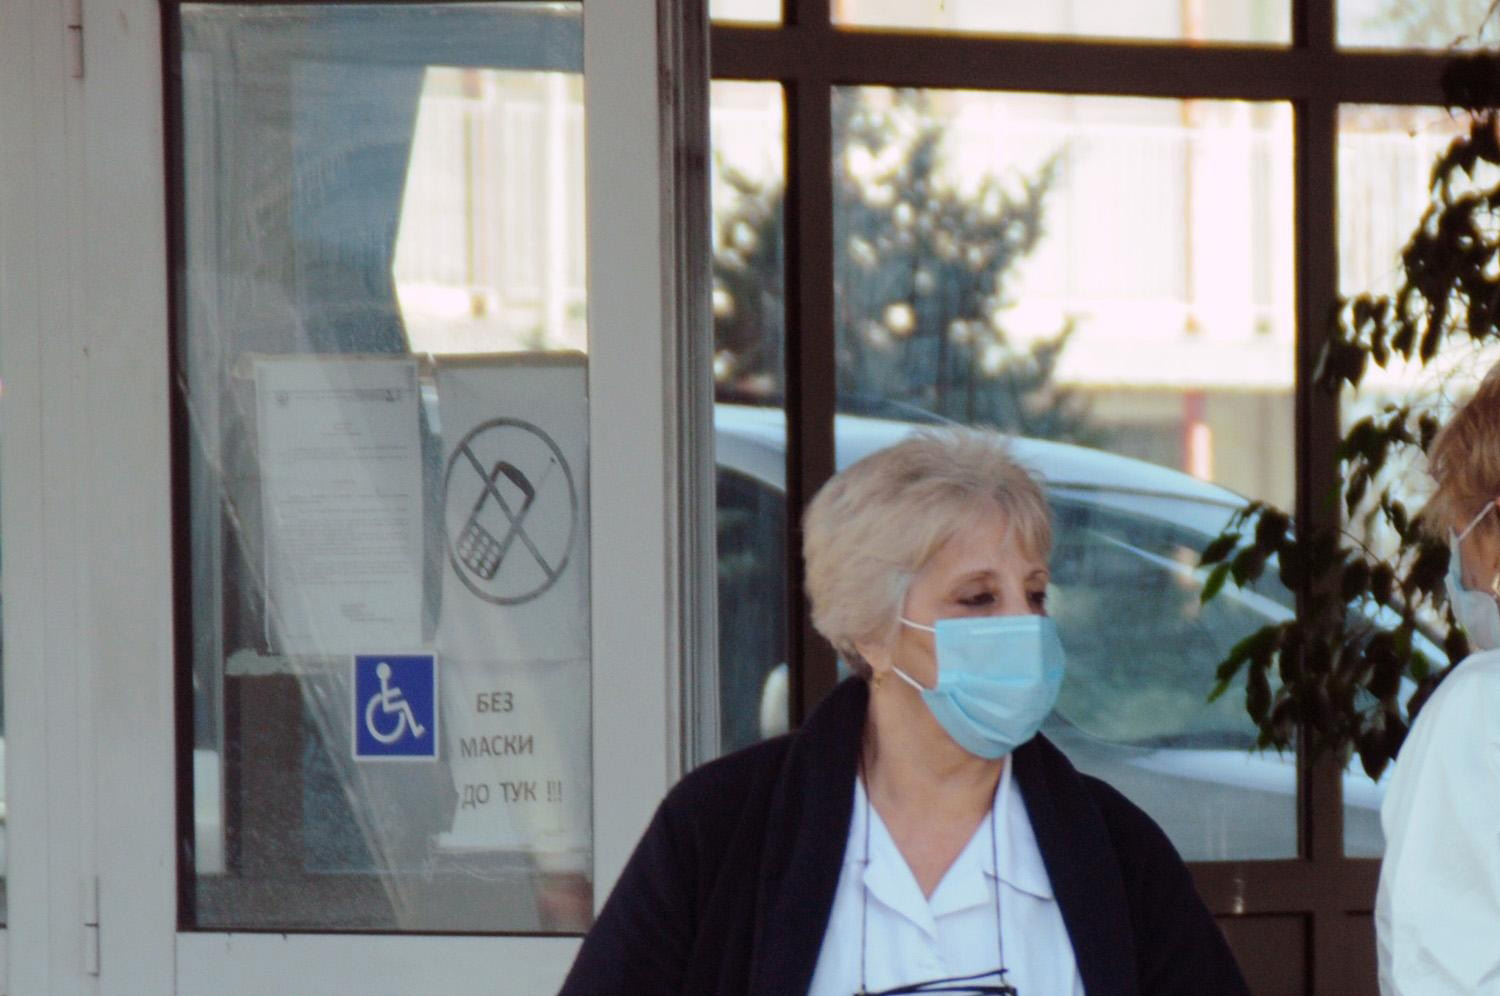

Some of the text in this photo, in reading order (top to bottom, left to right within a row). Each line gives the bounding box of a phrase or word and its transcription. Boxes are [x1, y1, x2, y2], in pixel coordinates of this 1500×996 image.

[476, 692, 514, 713] БЕЗ
[460, 735, 534, 757] МАСКИ
[462, 783, 490, 810] ДО
[499, 781, 537, 803] ТУК
